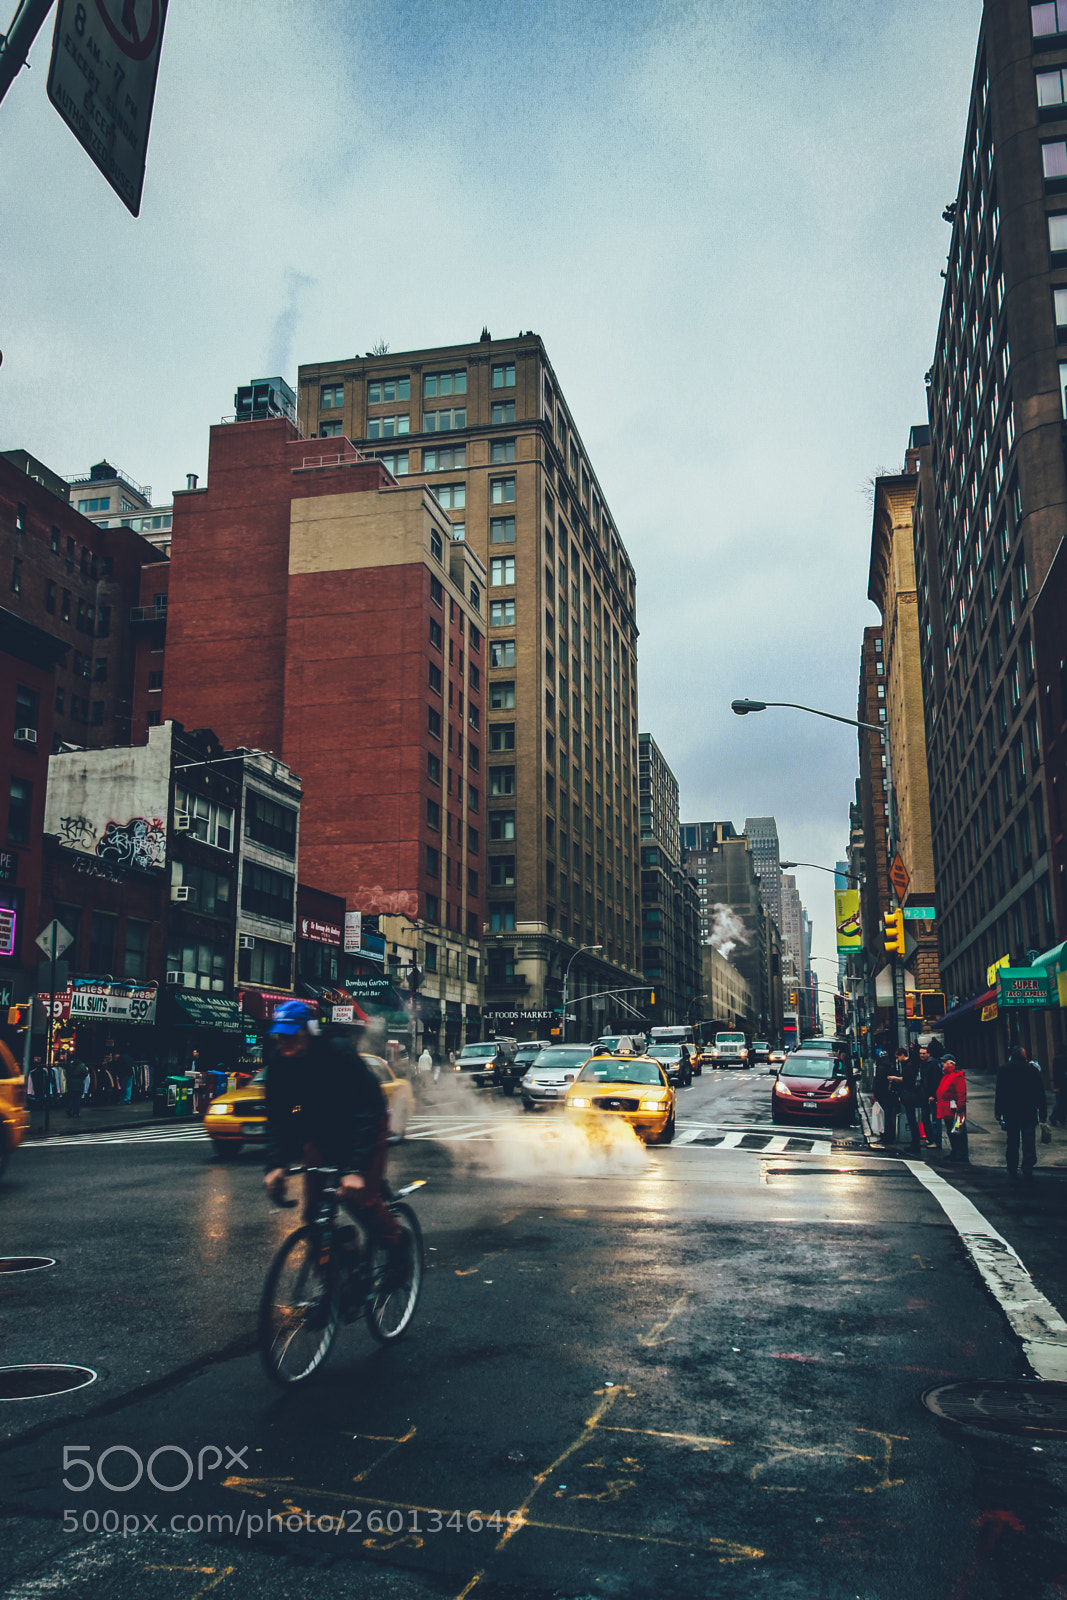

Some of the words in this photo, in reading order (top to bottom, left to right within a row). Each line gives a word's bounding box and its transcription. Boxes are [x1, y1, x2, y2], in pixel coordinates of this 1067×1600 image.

[74, 3, 87, 37] 8
[113, 62, 126, 91] 7
[125, 92, 138, 120] PM
[64, 33, 100, 94] EXCEPT
[105, 95, 138, 151] SUNDAY
[83, 88, 116, 147] EXCEPT
[55, 83, 108, 162] AUTHORIZED
[109, 156, 135, 201] BUSES
[903, 910, 911, 918] W
[913, 909, 926, 918] 23
[345, 978, 368, 988] Bombay
[368, 978, 389, 987] Garden
[1012, 980, 1038, 990] SUPER
[71, 995, 86, 1011] ALL
[87, 996, 108, 1012] SUITS
[181, 994, 205, 1004] PARK
[495, 1011, 519, 1019] FOODS
[520, 1011, 553, 1019] MARKET
